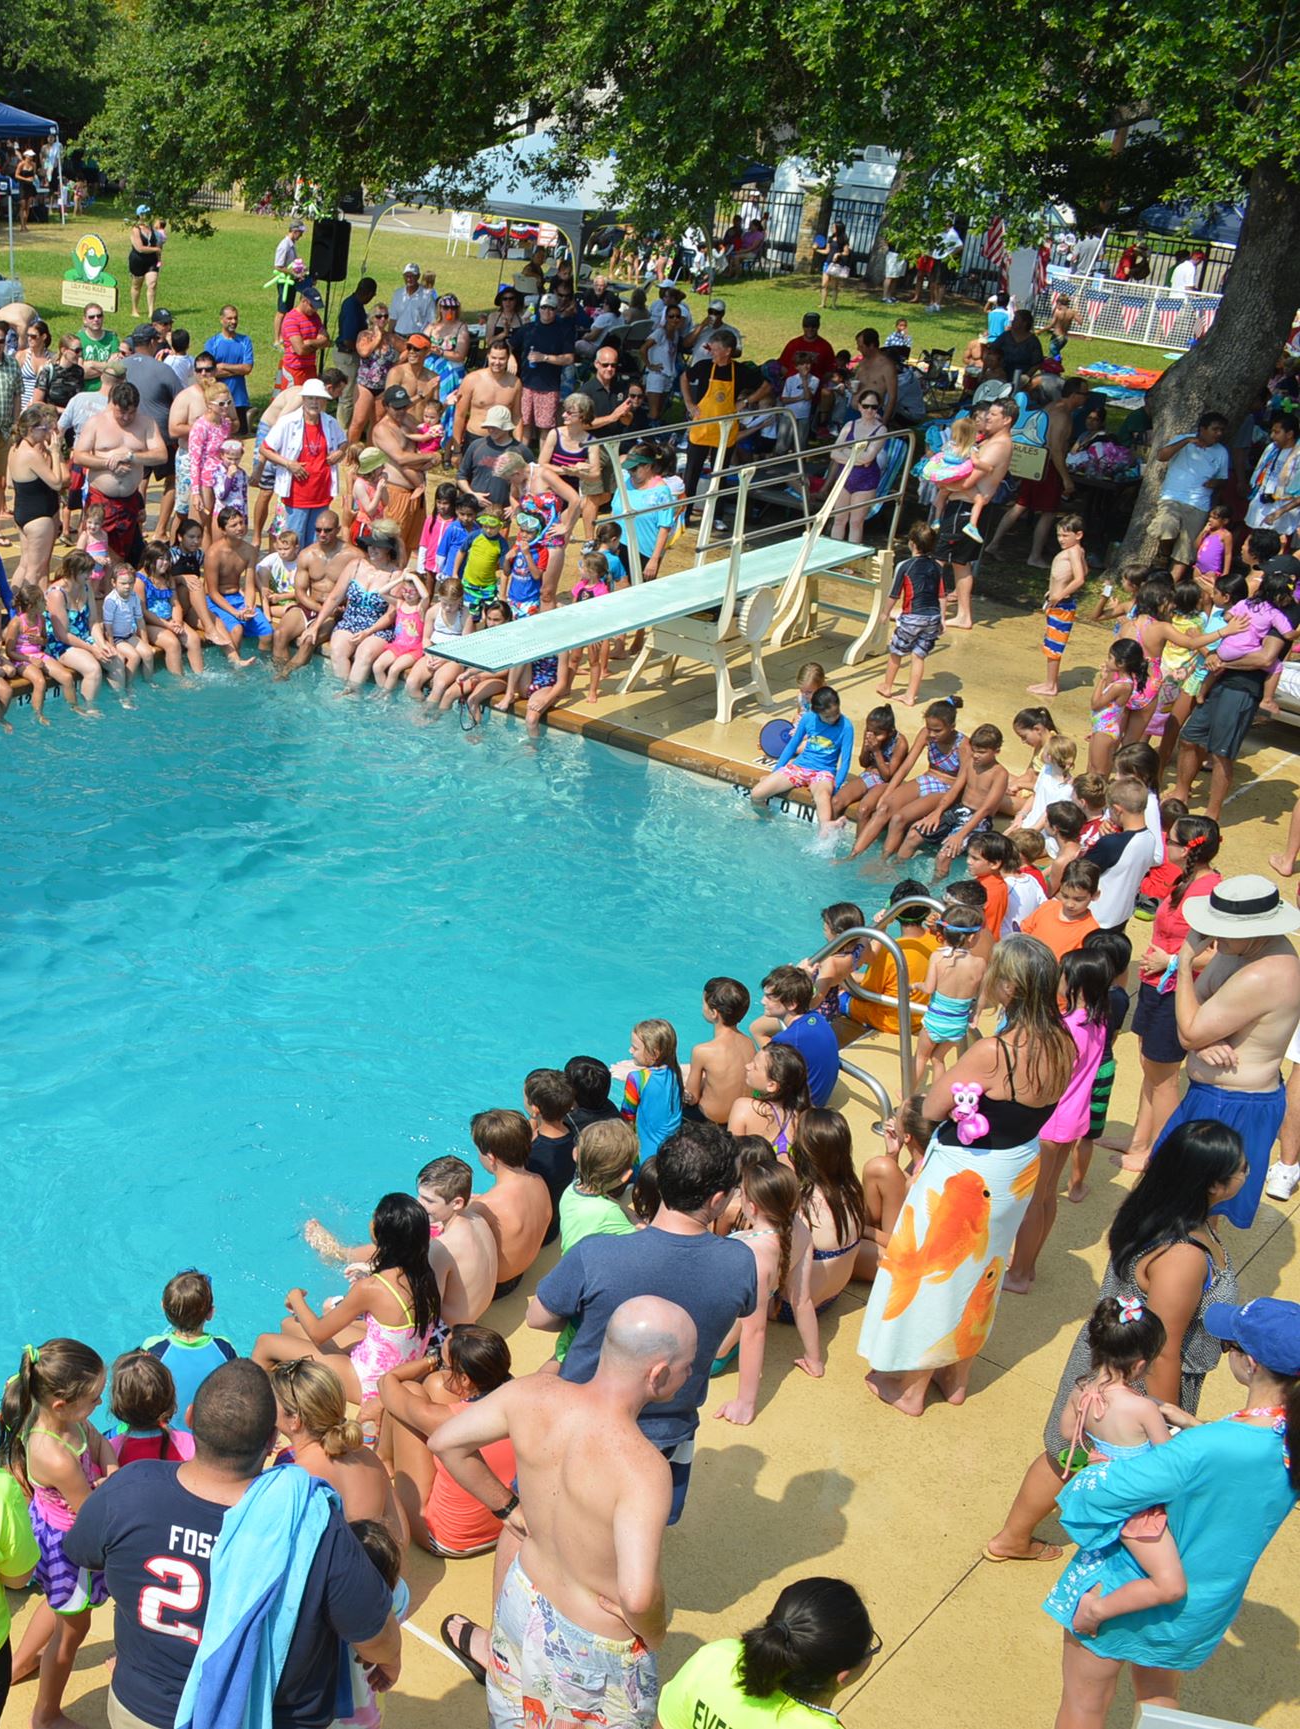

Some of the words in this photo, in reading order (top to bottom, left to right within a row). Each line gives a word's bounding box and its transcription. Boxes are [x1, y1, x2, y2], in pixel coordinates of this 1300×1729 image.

[1013, 444, 1039, 456] RULES
[797, 803, 816, 823] IN
[168, 1524, 220, 1559] FOS
[138, 1554, 204, 1646] 2
